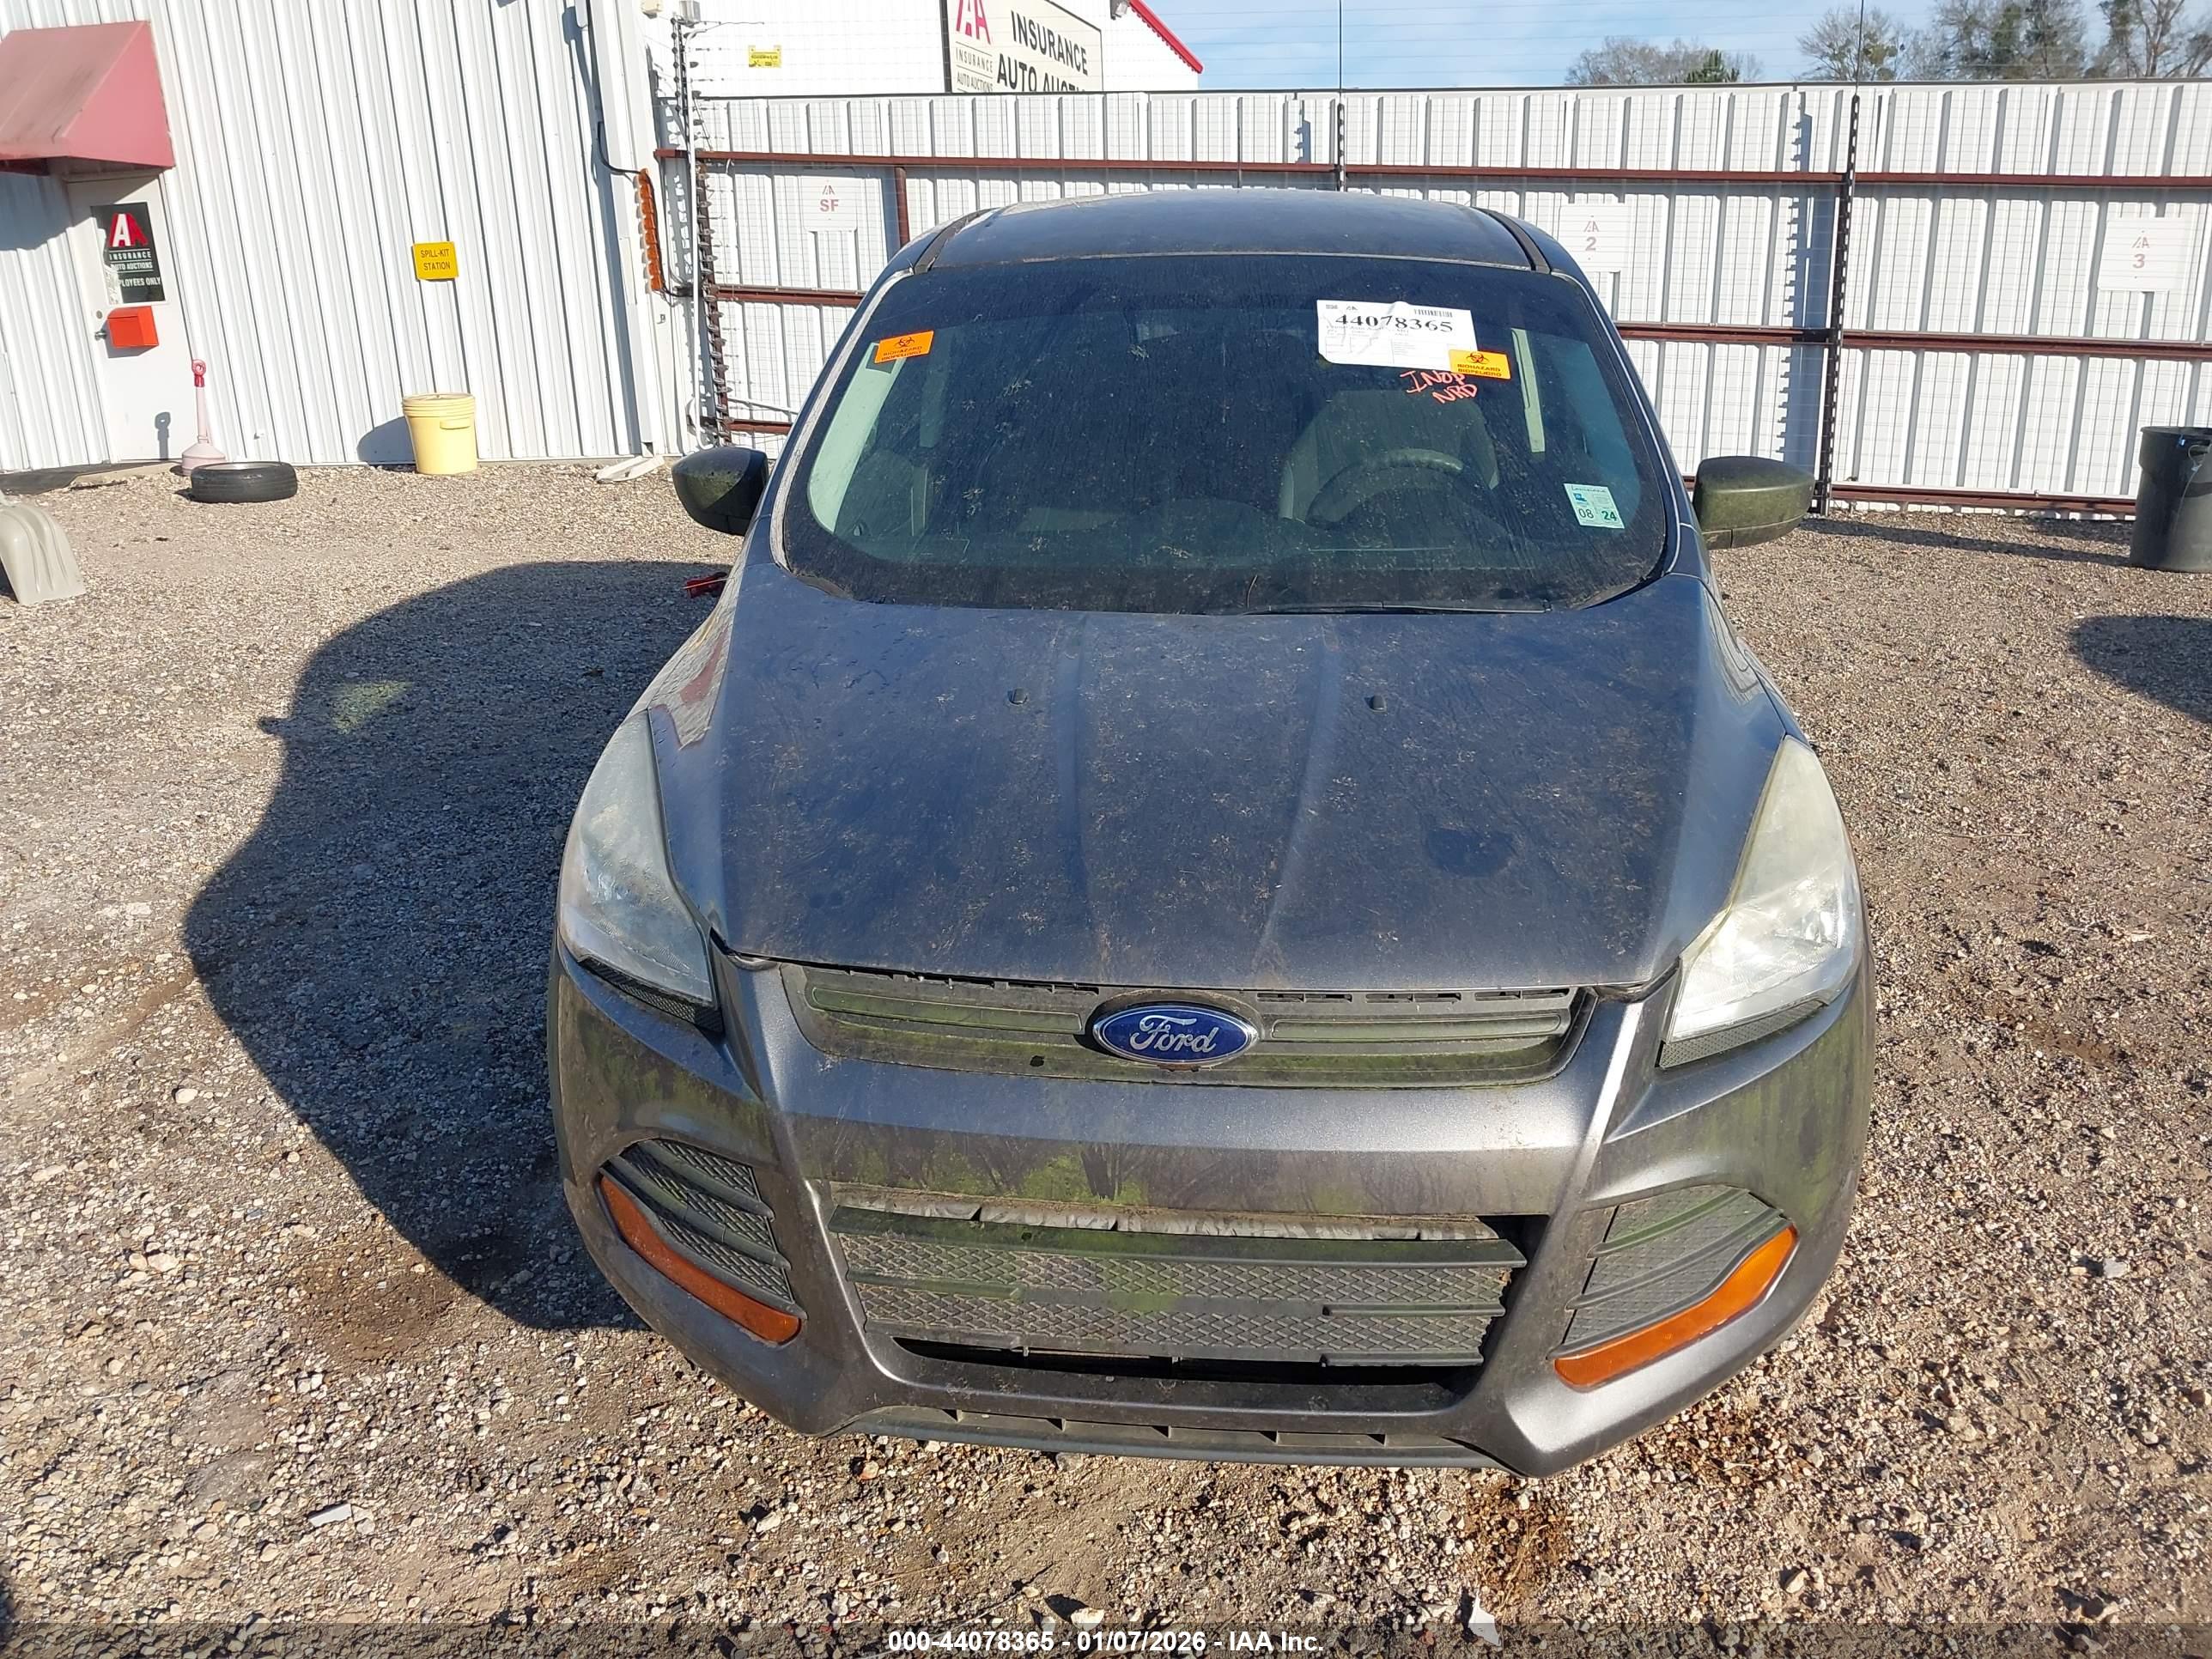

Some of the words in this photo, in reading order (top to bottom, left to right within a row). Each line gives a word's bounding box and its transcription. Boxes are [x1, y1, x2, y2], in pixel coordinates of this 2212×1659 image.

[1011, 10, 1088, 76] INSURANCE
[956, 47, 993, 74] INSURANCE
[997, 53, 1036, 91] AUTO
[957, 71, 970, 88] AUTO
[970, 76, 993, 93] AUCTIONS
[819, 198, 839, 212] SF
[1585, 236, 1596, 251] 2
[109, 251, 152, 260] INSURANCE
[420, 249, 449, 258] SPILL-KIT
[126, 261, 153, 270] AUCTIONS
[423, 261, 451, 270] STATION
[2133, 253, 2145, 269] 3
[146, 276, 161, 286] ONLY
[1335, 314, 1453, 333] 44078365
[1457, 363, 1501, 373] BIOHAZARD
[1457, 368, 1503, 378] BIOPELIGRO
[1400, 369, 1466, 393] INOP
[1578, 508, 1594, 519] 08
[1601, 511, 1617, 521] 24
[1129, 1014, 1219, 1054] Ford
